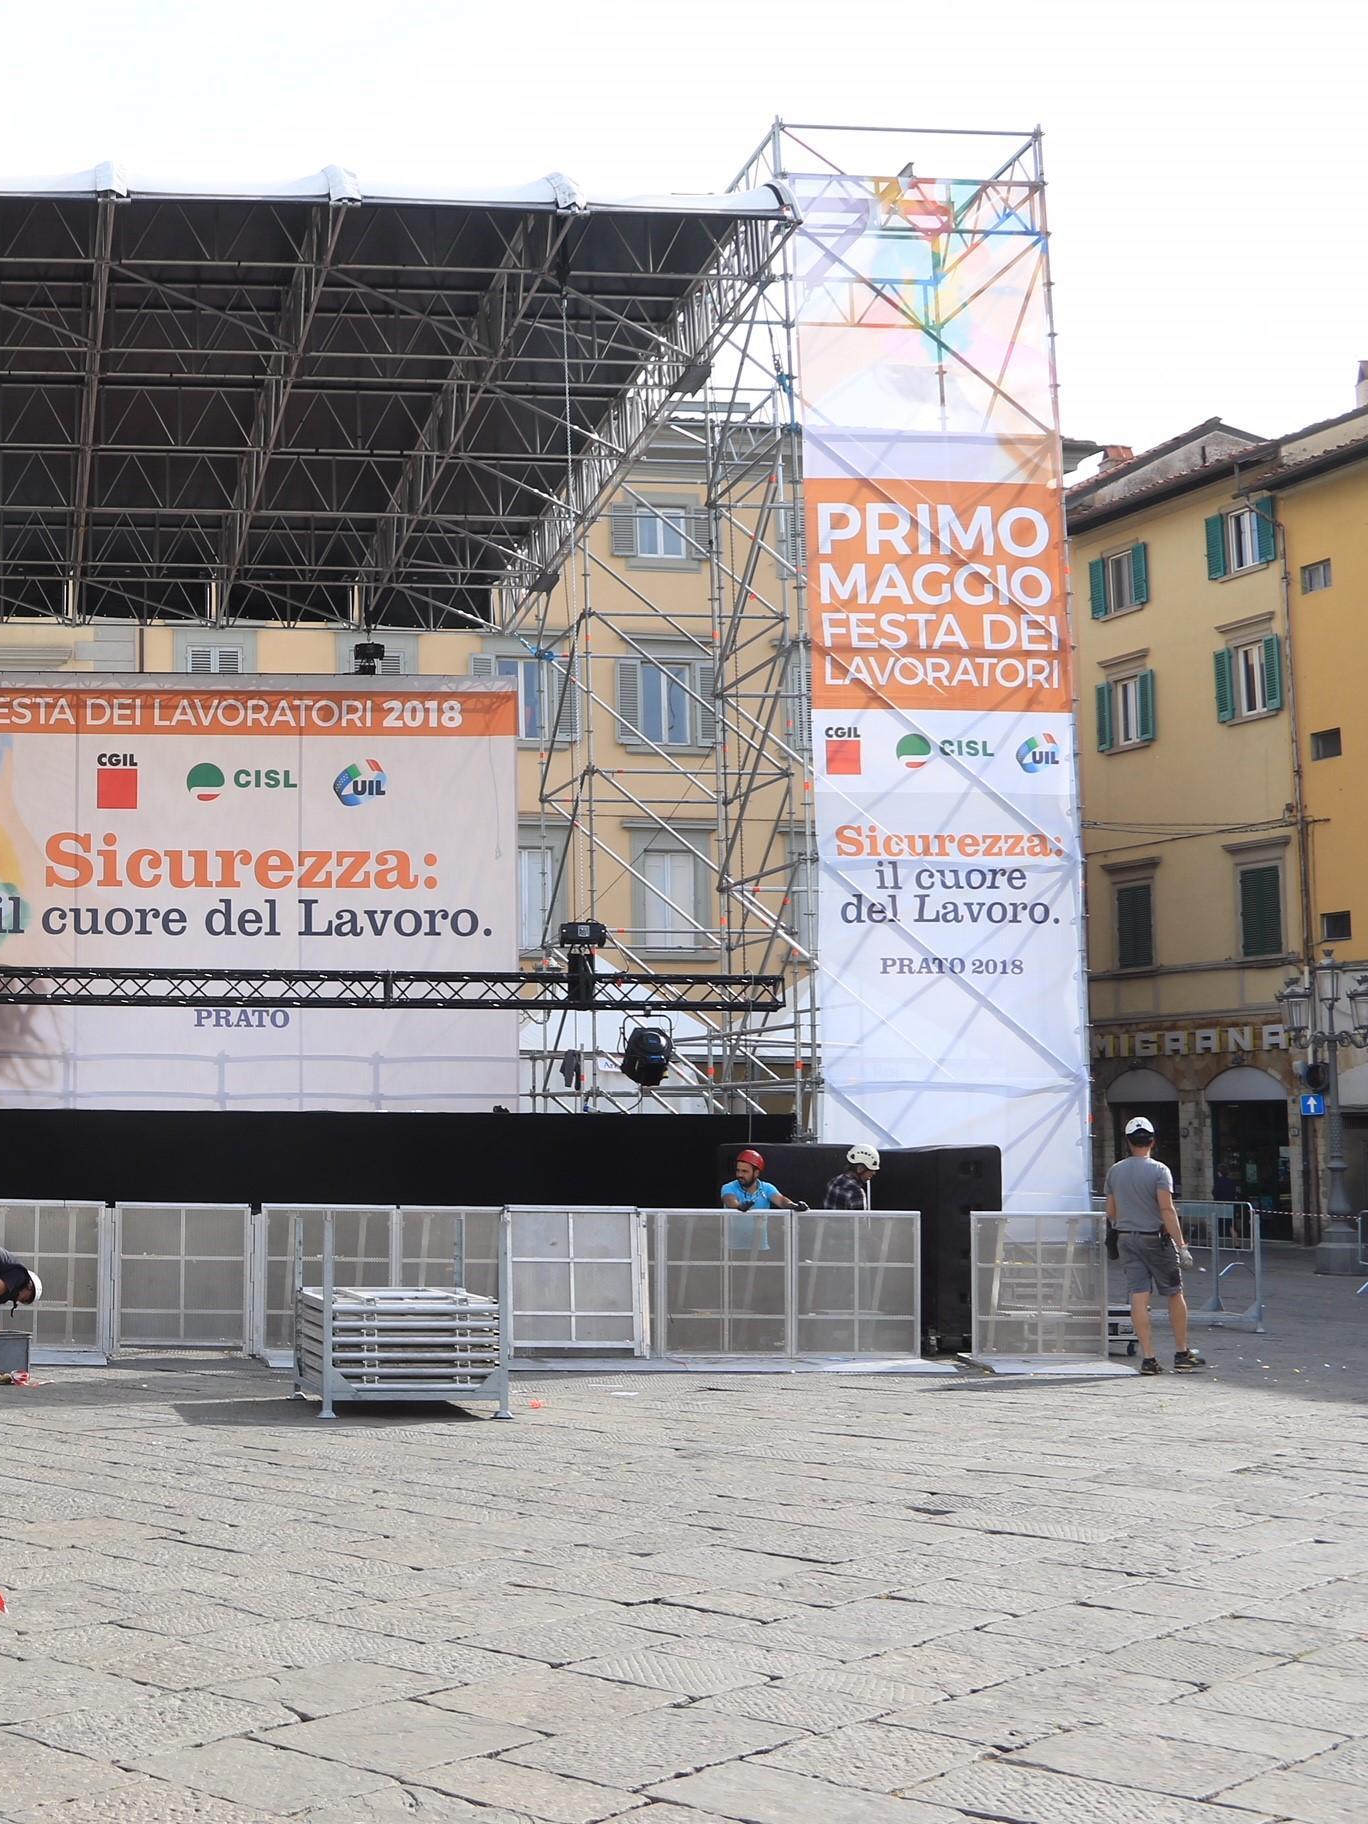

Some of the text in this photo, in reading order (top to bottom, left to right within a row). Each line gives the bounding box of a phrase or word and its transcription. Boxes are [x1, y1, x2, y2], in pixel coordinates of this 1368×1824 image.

[818, 502, 1050, 557] PRIMO
[820, 562, 1052, 607] MAGGIO
[822, 612, 1059, 652] FESTA DEI
[825, 655, 1060, 689] LAVORATORI
[85, 698, 142, 727] DEI
[153, 698, 373, 728] LAVORATORI
[382, 699, 463, 729] 2018
[824, 727, 861, 739] CGIL
[97, 752, 138, 767] CGIL
[940, 739, 995, 758] CISL
[1031, 751, 1060, 766] UIL
[233, 769, 298, 789] CISL
[352, 779, 386, 796] UIL
[836, 825, 1065, 858] Sicurezza:
[44, 831, 439, 890] Sicurezza:
[875, 861, 1028, 891] il cuore
[40, 904, 188, 937] cuore
[204, 898, 282, 937] del
[297, 898, 493, 938] Lavoro.
[840, 894, 1061, 925] del Lavoro.
[880, 957, 1024, 976] PRATO 2018
[194, 1008, 291, 1029] PRATO
